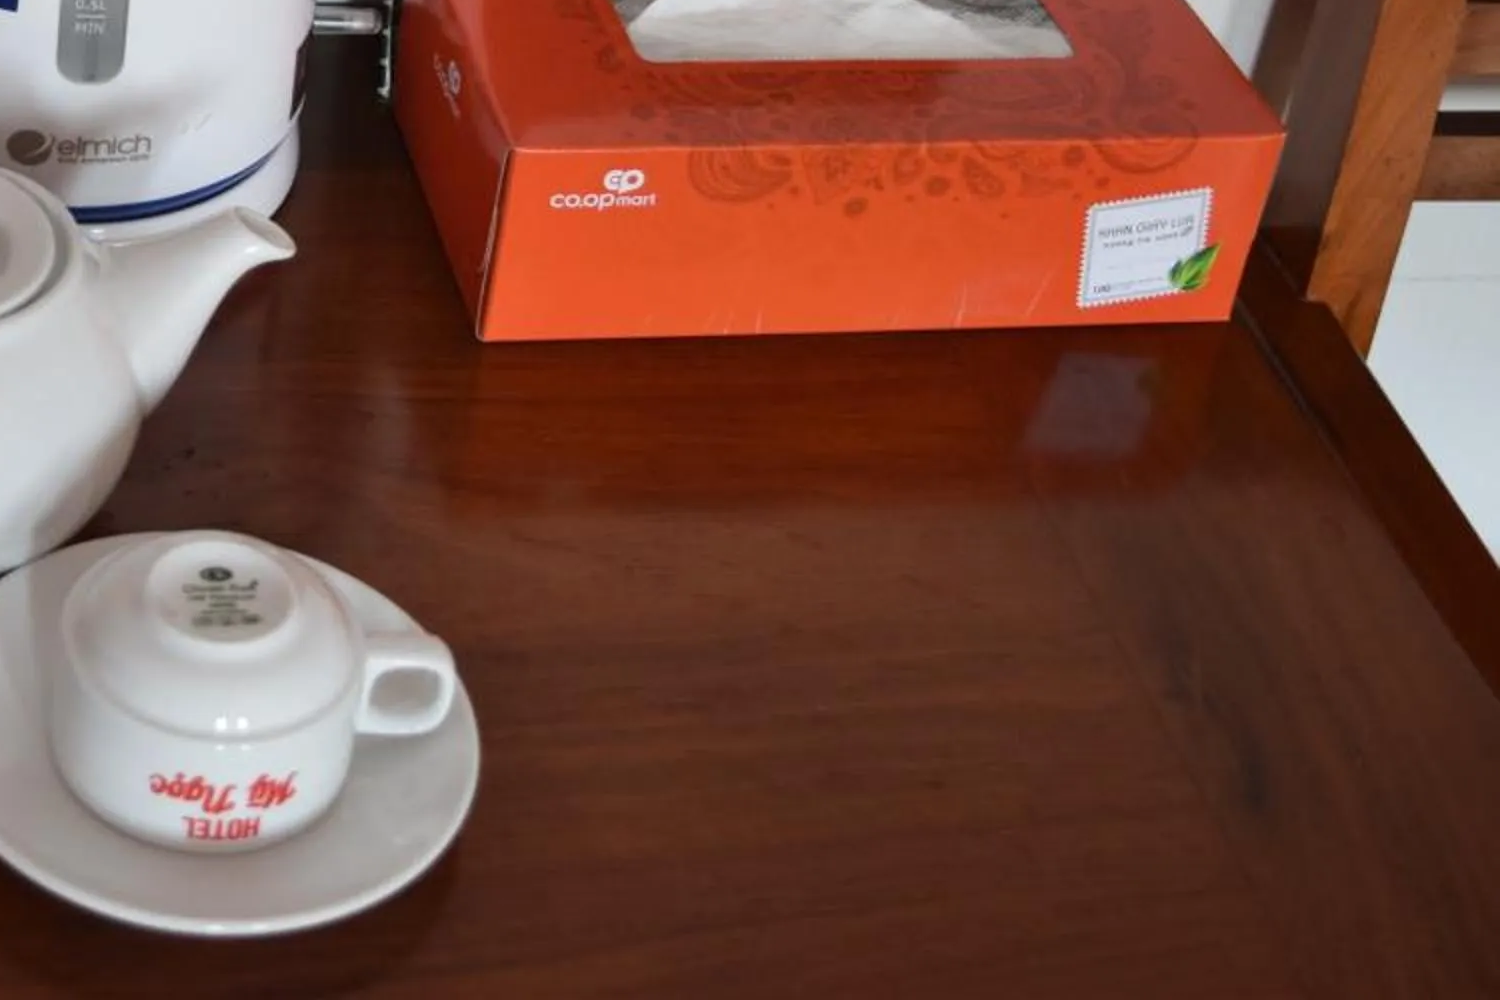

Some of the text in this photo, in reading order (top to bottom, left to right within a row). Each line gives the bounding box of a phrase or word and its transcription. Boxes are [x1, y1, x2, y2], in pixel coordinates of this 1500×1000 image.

[57, 134, 151, 156] elmich
[150, 771, 237, 814] Ngọc
[183, 814, 261, 841] HOTEL
